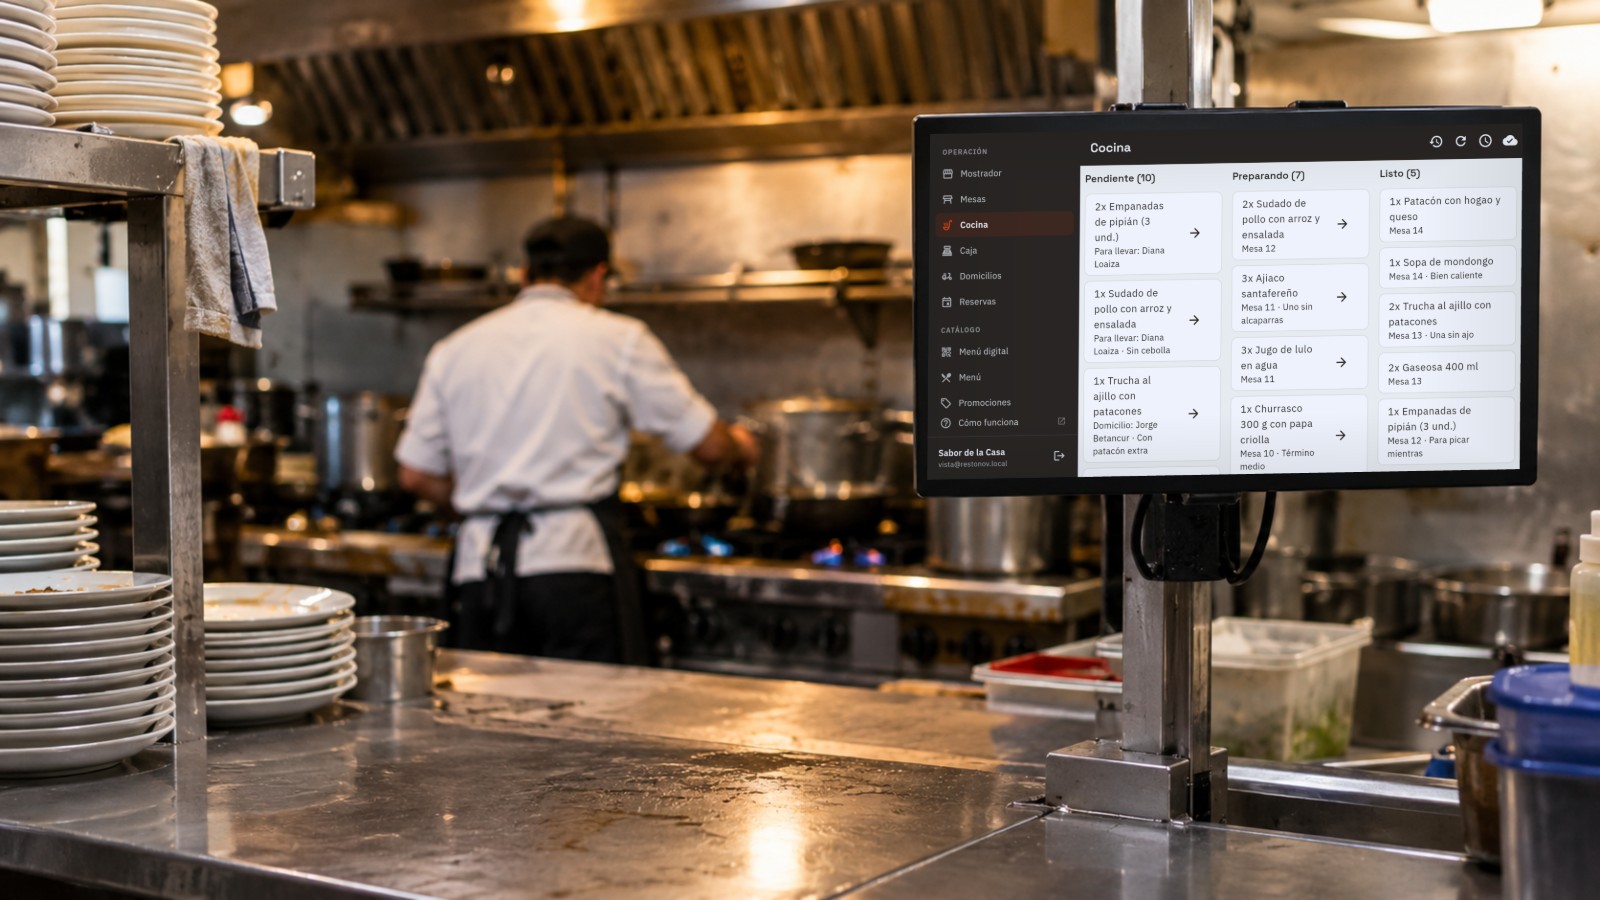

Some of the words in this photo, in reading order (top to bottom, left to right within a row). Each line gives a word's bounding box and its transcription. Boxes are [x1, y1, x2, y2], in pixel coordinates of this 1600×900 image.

[943, 147, 987, 155] OPERACIÓN
[1091, 143, 1131, 152] Cocina
[1233, 172, 1288, 181] Preparando
[1292, 171, 1304, 181] (7)
[1407, 169, 1420, 179] (5)
[1086, 175, 1134, 183] Pendiente
[1137, 174, 1155, 184] (10)
[1243, 200, 1253, 208] 2x
[1257, 199, 1291, 208] Sudado
[1295, 199, 1306, 207] de
[1405, 196, 1441, 205] Patacón
[1465, 196, 1492, 206] hogao
[1096, 203, 1106, 211] 2x
[1110, 202, 1163, 212] Empanadas
[1095, 218, 1106, 226] de
[1110, 217, 1138, 228] pipián
[1141, 217, 1150, 226] (3
[1243, 215, 1265, 225] pollo
[1315, 216, 1320, 224] y
[1390, 214, 1417, 222] queso
[1095, 233, 1118, 242] und.)
[1242, 230, 1284, 239] ensalada
[960, 247, 977, 256] Caja
[1095, 260, 1120, 268] Loaiza
[1390, 259, 1400, 267] 1x
[1404, 259, 1426, 268] Sopa
[1430, 258, 1441, 266] de
[1444, 257, 1493, 267] mondongo
[960, 272, 1001, 280] Domicilios
[1256, 274, 1284, 284] Ajiaco
[1095, 290, 1105, 298] 1x
[1109, 289, 1143, 297] Sudado
[1147, 289, 1158, 297] de
[1242, 289, 1298, 298] santafereño
[1095, 305, 1117, 315] pollo
[1167, 306, 1171, 314] y
[1403, 302, 1435, 310] Trucha
[1438, 301, 1446, 309] al
[1449, 301, 1471, 311] ajillo
[1094, 320, 1136, 328] ensalada
[1241, 317, 1283, 325] alcaparras
[1389, 319, 1437, 327] patacones
[1462, 331, 1474, 340] ajo
[960, 347, 981, 355] Menú
[984, 348, 1008, 356] digital
[1241, 346, 1252, 354] 3x
[1255, 346, 1277, 355] Jugo
[1296, 345, 1312, 353] lulo
[1255, 362, 1277, 371] agua
[1389, 364, 1399, 372] 2x
[1467, 362, 1478, 370] ml
[959, 373, 981, 381] Menú
[1094, 377, 1104, 385] 1x
[1108, 376, 1139, 385] Trucha
[1143, 376, 1151, 384] al
[1094, 392, 1116, 402] ajillo
[1094, 408, 1141, 417] patacones
[1241, 405, 1252, 413] 1x
[1255, 405, 1302, 413] Churrasco
[1389, 408, 1399, 416] 1x
[1403, 406, 1456, 417] Empanadas
[1460, 406, 1471, 414] de
[984, 418, 1018, 426] funciona
[1136, 421, 1157, 430] Jorge
[1262, 421, 1267, 430] g
[1290, 421, 1312, 429] papa
[1388, 422, 1416, 433] pipián
[1420, 422, 1428, 431] (3
[1432, 421, 1456, 431] und.)
[1241, 435, 1269, 444] criolla
[1450, 436, 1469, 445] picar
[1093, 447, 1125, 456] patacón
[939, 460, 1007, 468] vista@restonov.local
